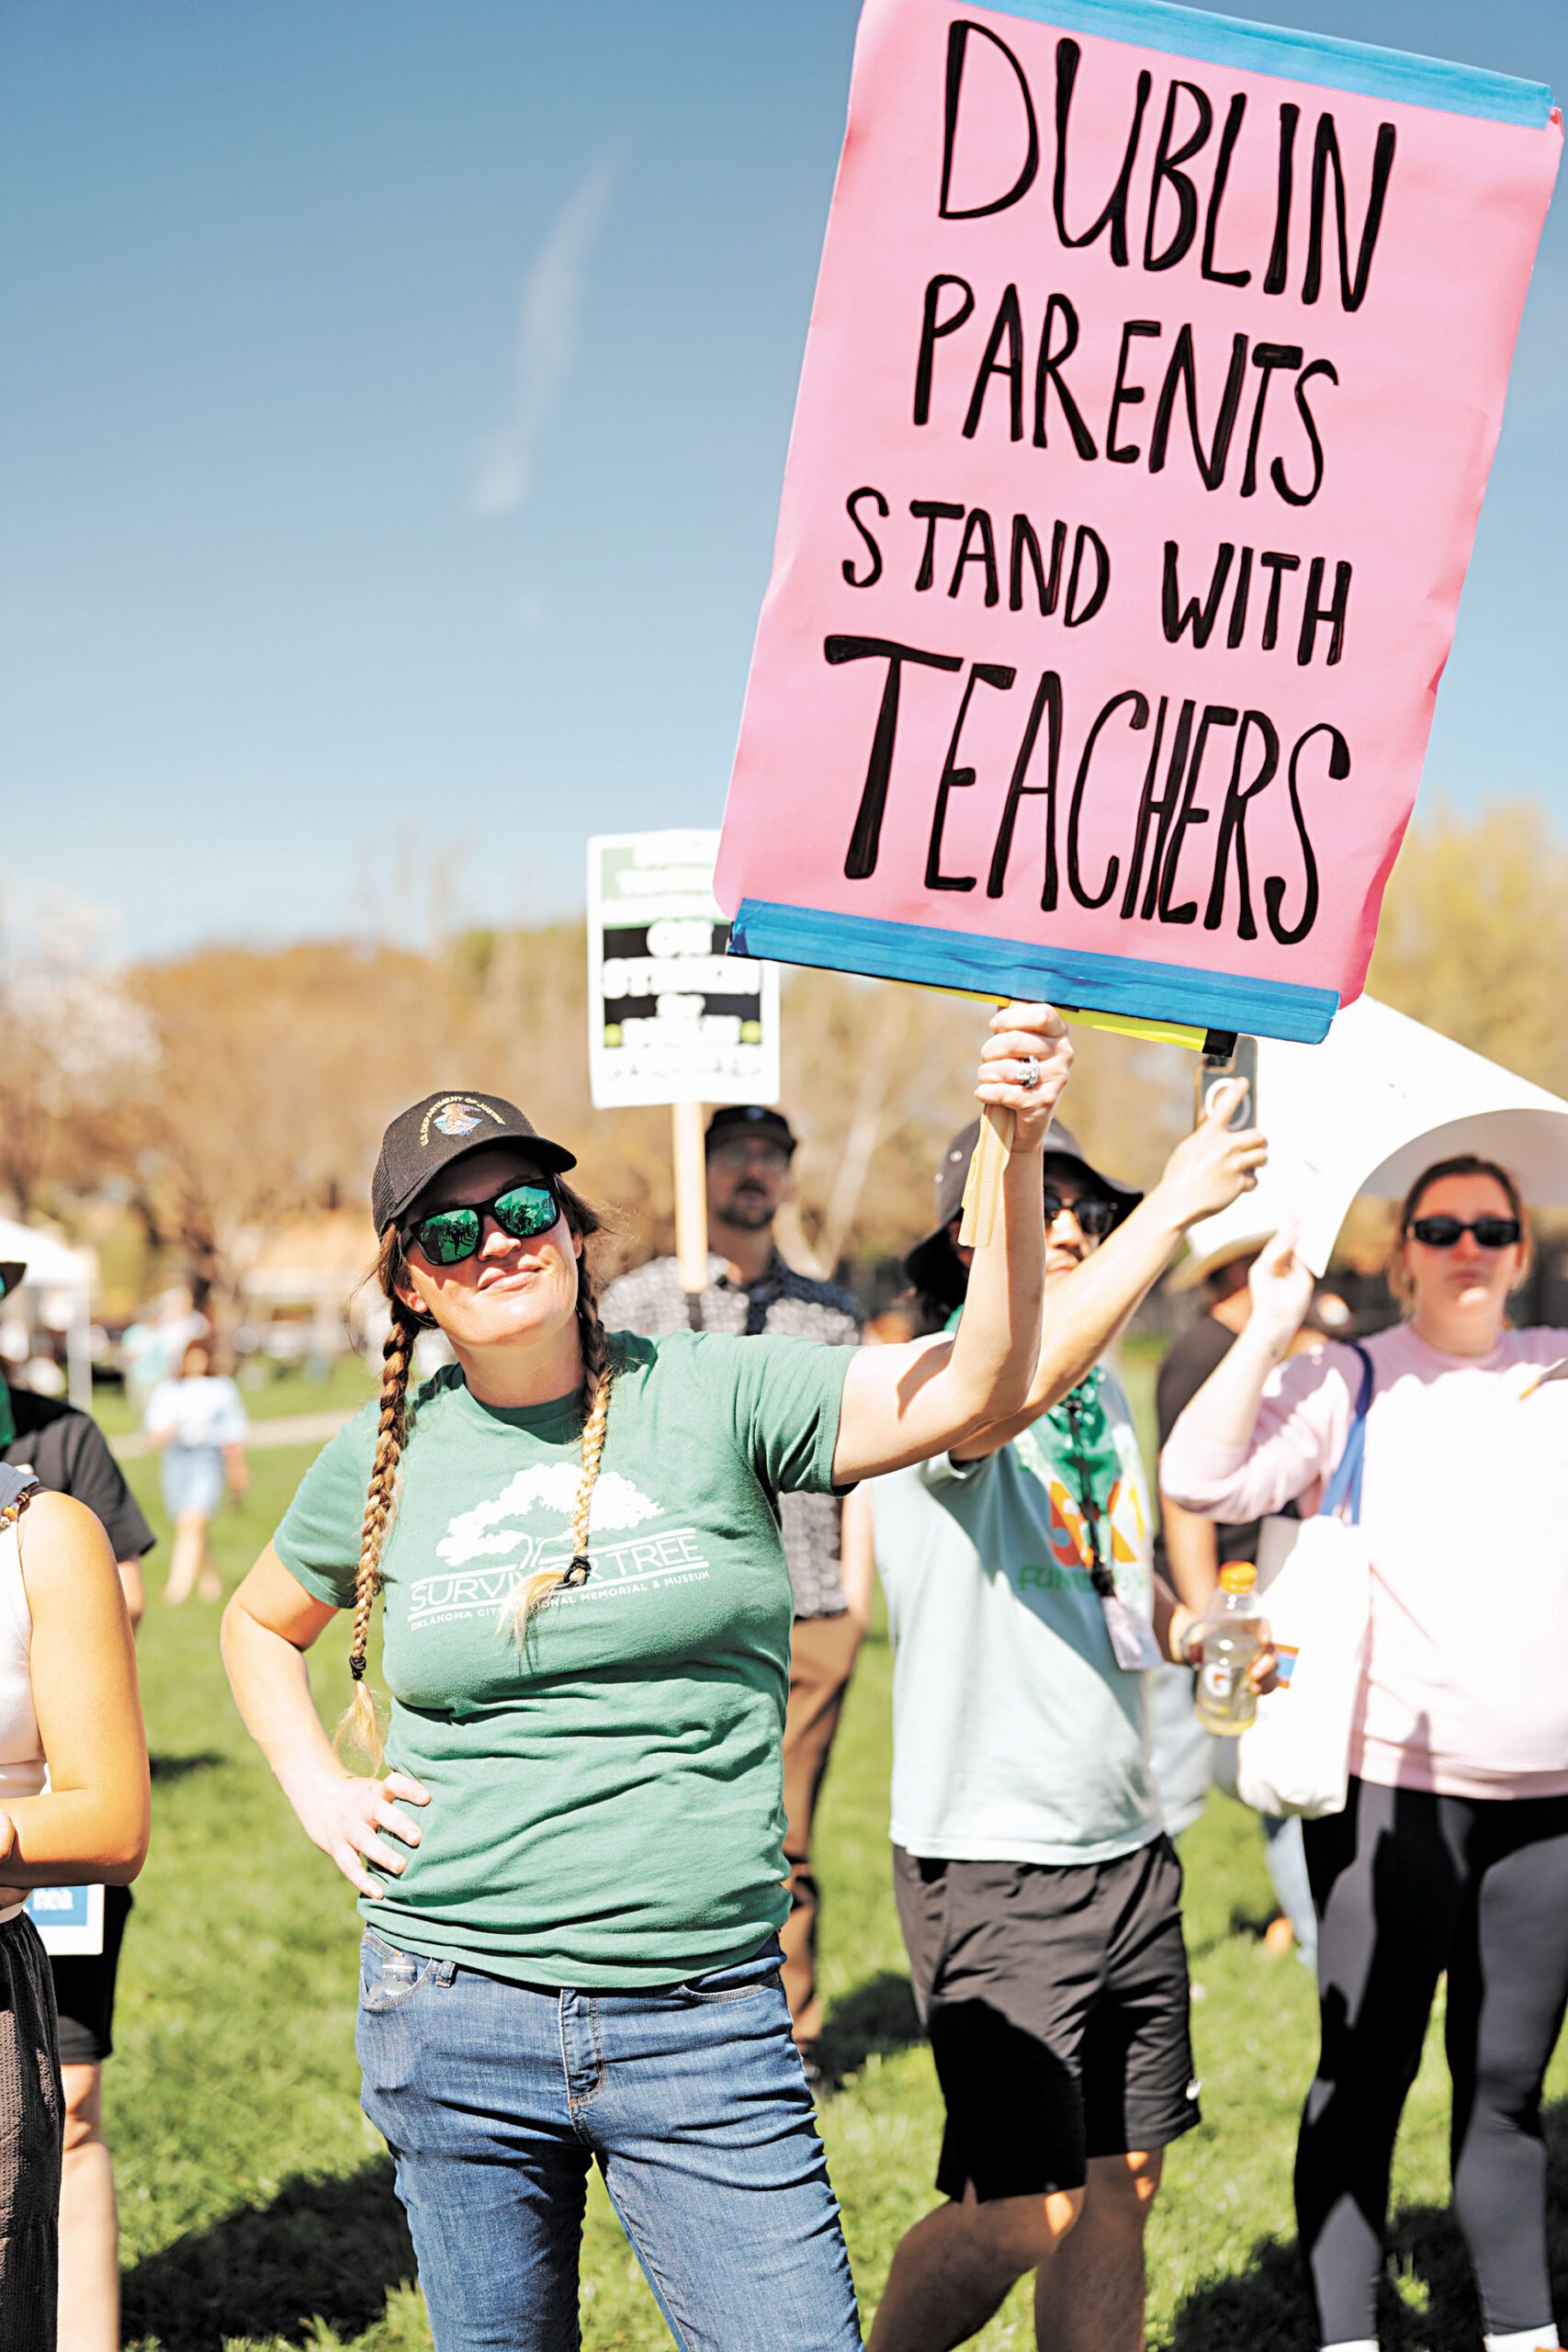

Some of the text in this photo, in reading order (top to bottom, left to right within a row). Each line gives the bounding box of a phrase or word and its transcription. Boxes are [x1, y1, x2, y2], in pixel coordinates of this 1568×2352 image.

[939, 20, 1395, 311] DUBLIN
[914, 275, 1337, 505] PARENTS
[842, 487, 1351, 665] STAND WITH
[825, 636, 1350, 944] TEACHERS
[421, 1096, 463, 1133] DEPARTMENT
[412, 1610, 472, 1631] OKLAHOMA
[478, 1607, 502, 1617] CIT
[581, 1583, 649, 1602] MEMORIAL
[652, 1579, 661, 1589] &
[664, 1571, 710, 1587] MUSEUM
[605, 1535, 704, 1577] TREE
[1204, 1664, 1231, 1697] G
